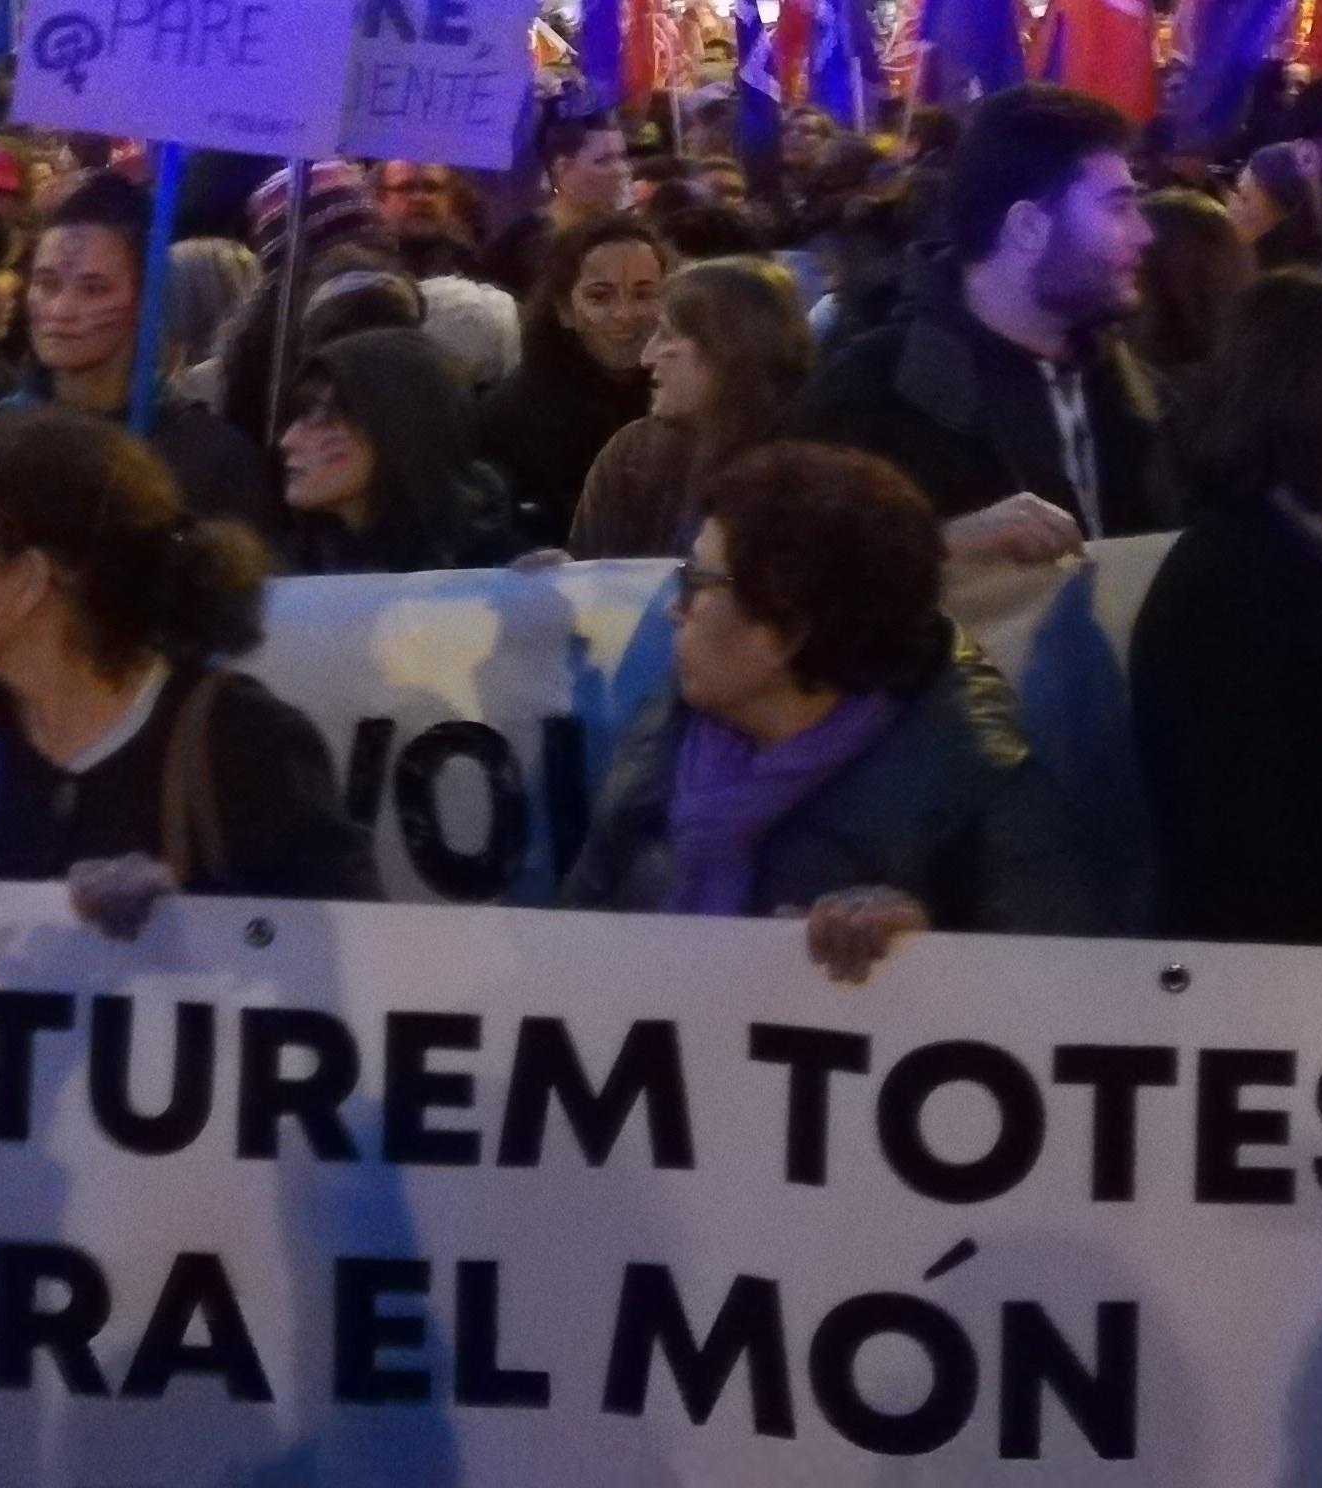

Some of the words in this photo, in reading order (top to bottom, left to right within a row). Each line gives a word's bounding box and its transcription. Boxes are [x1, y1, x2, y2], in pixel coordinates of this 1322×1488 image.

[347, 61, 501, 129] IENTE
[333, 1257, 551, 1409] EL
[601, 1237, 1141, 1461] MÓN
